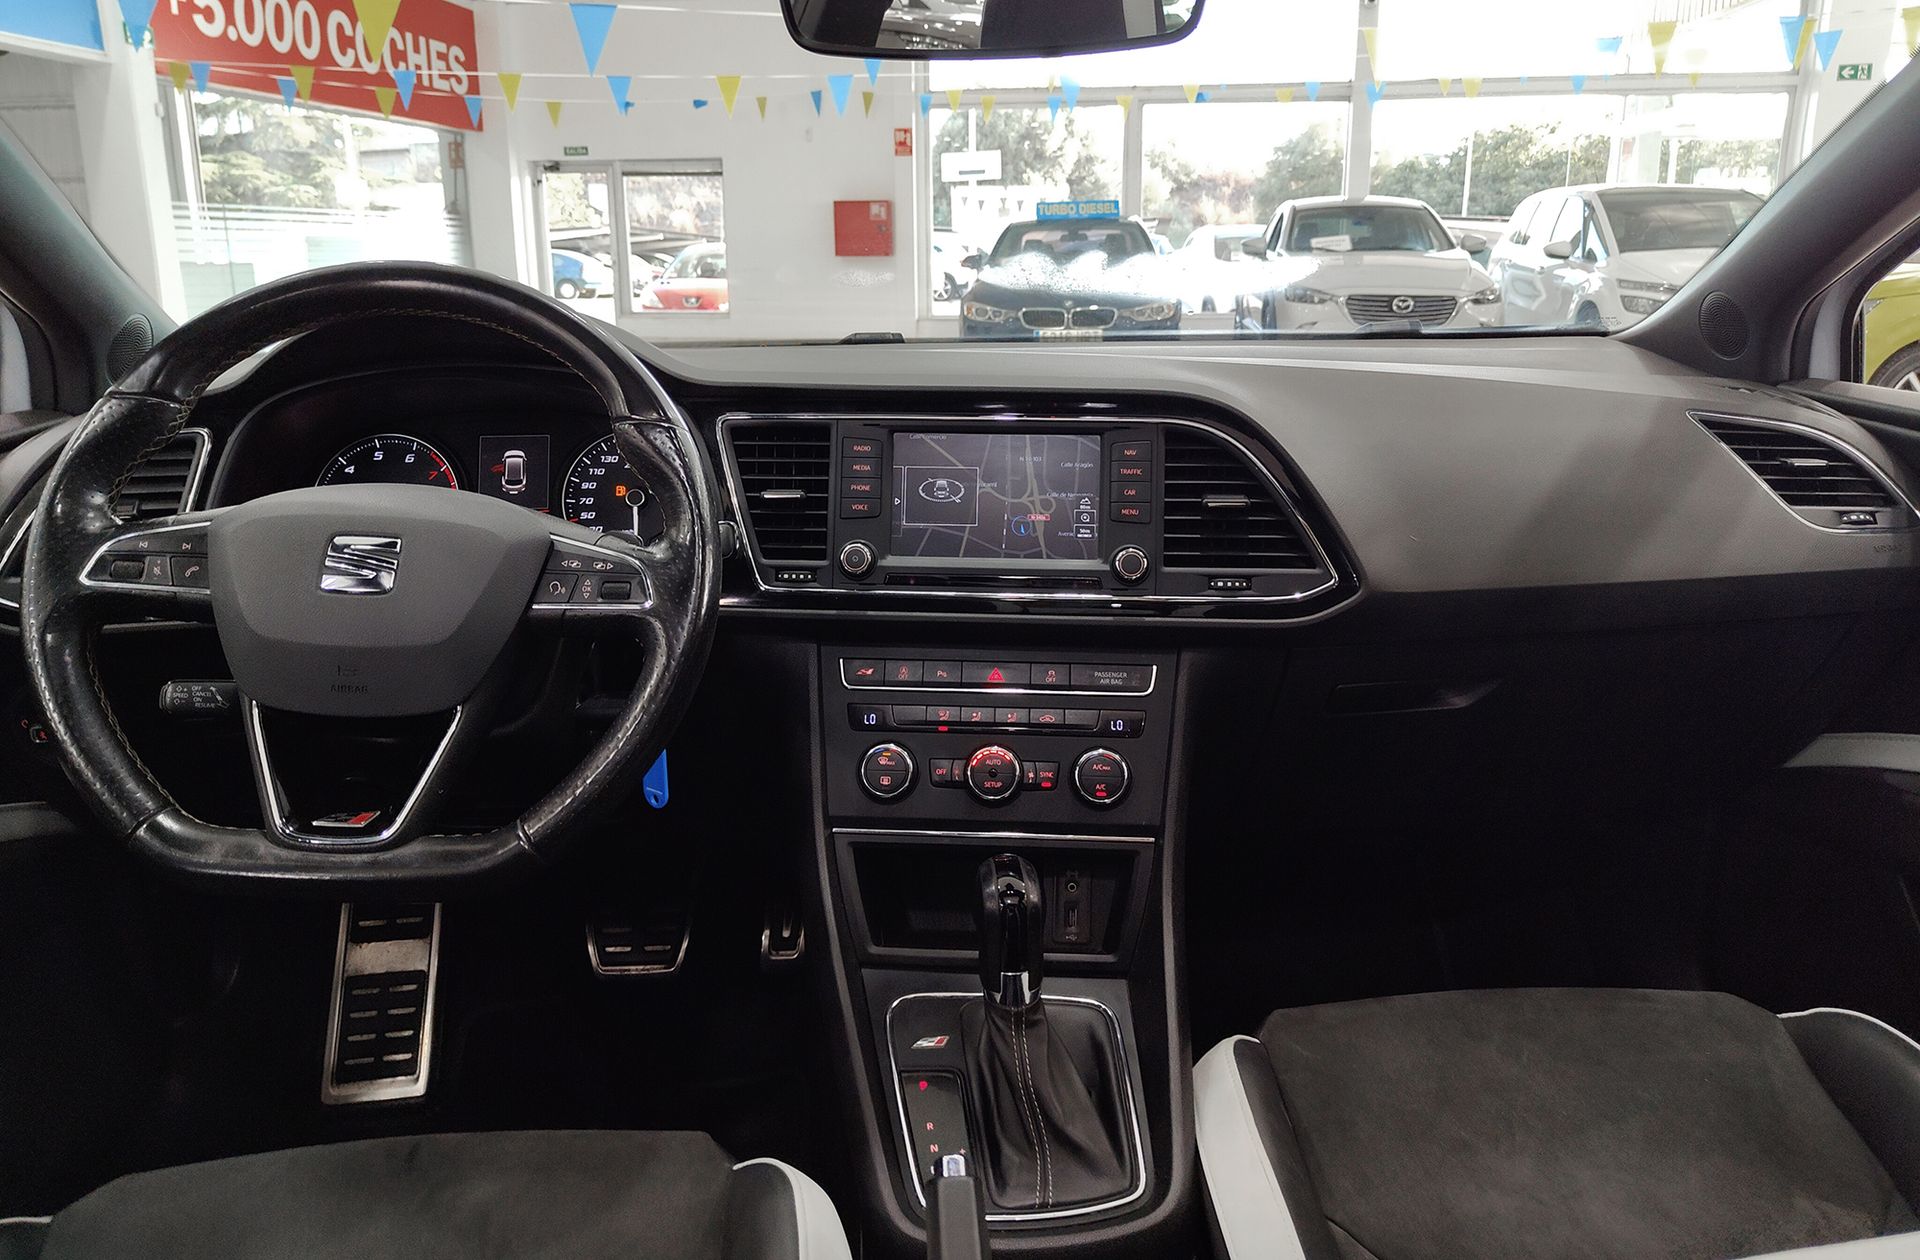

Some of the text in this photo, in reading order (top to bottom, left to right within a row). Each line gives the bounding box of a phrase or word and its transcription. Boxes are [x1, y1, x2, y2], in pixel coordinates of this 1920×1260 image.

[327, 9, 469, 95] COCHES
[1038, 202, 1118, 216] TURBO DIESEL
[373, 451, 384, 460] 5
[405, 454, 415, 463] 6
[600, 455, 619, 463] 130
[344, 465, 355, 474] 4
[428, 471, 438, 480] 7
[850, 484, 871, 492] PHONE
[579, 497, 594, 505] 70
[851, 503, 869, 511] VOICE
[580, 511, 596, 519] 50
[926, 1122, 934, 1131] R
[930, 1143, 939, 1153] N
